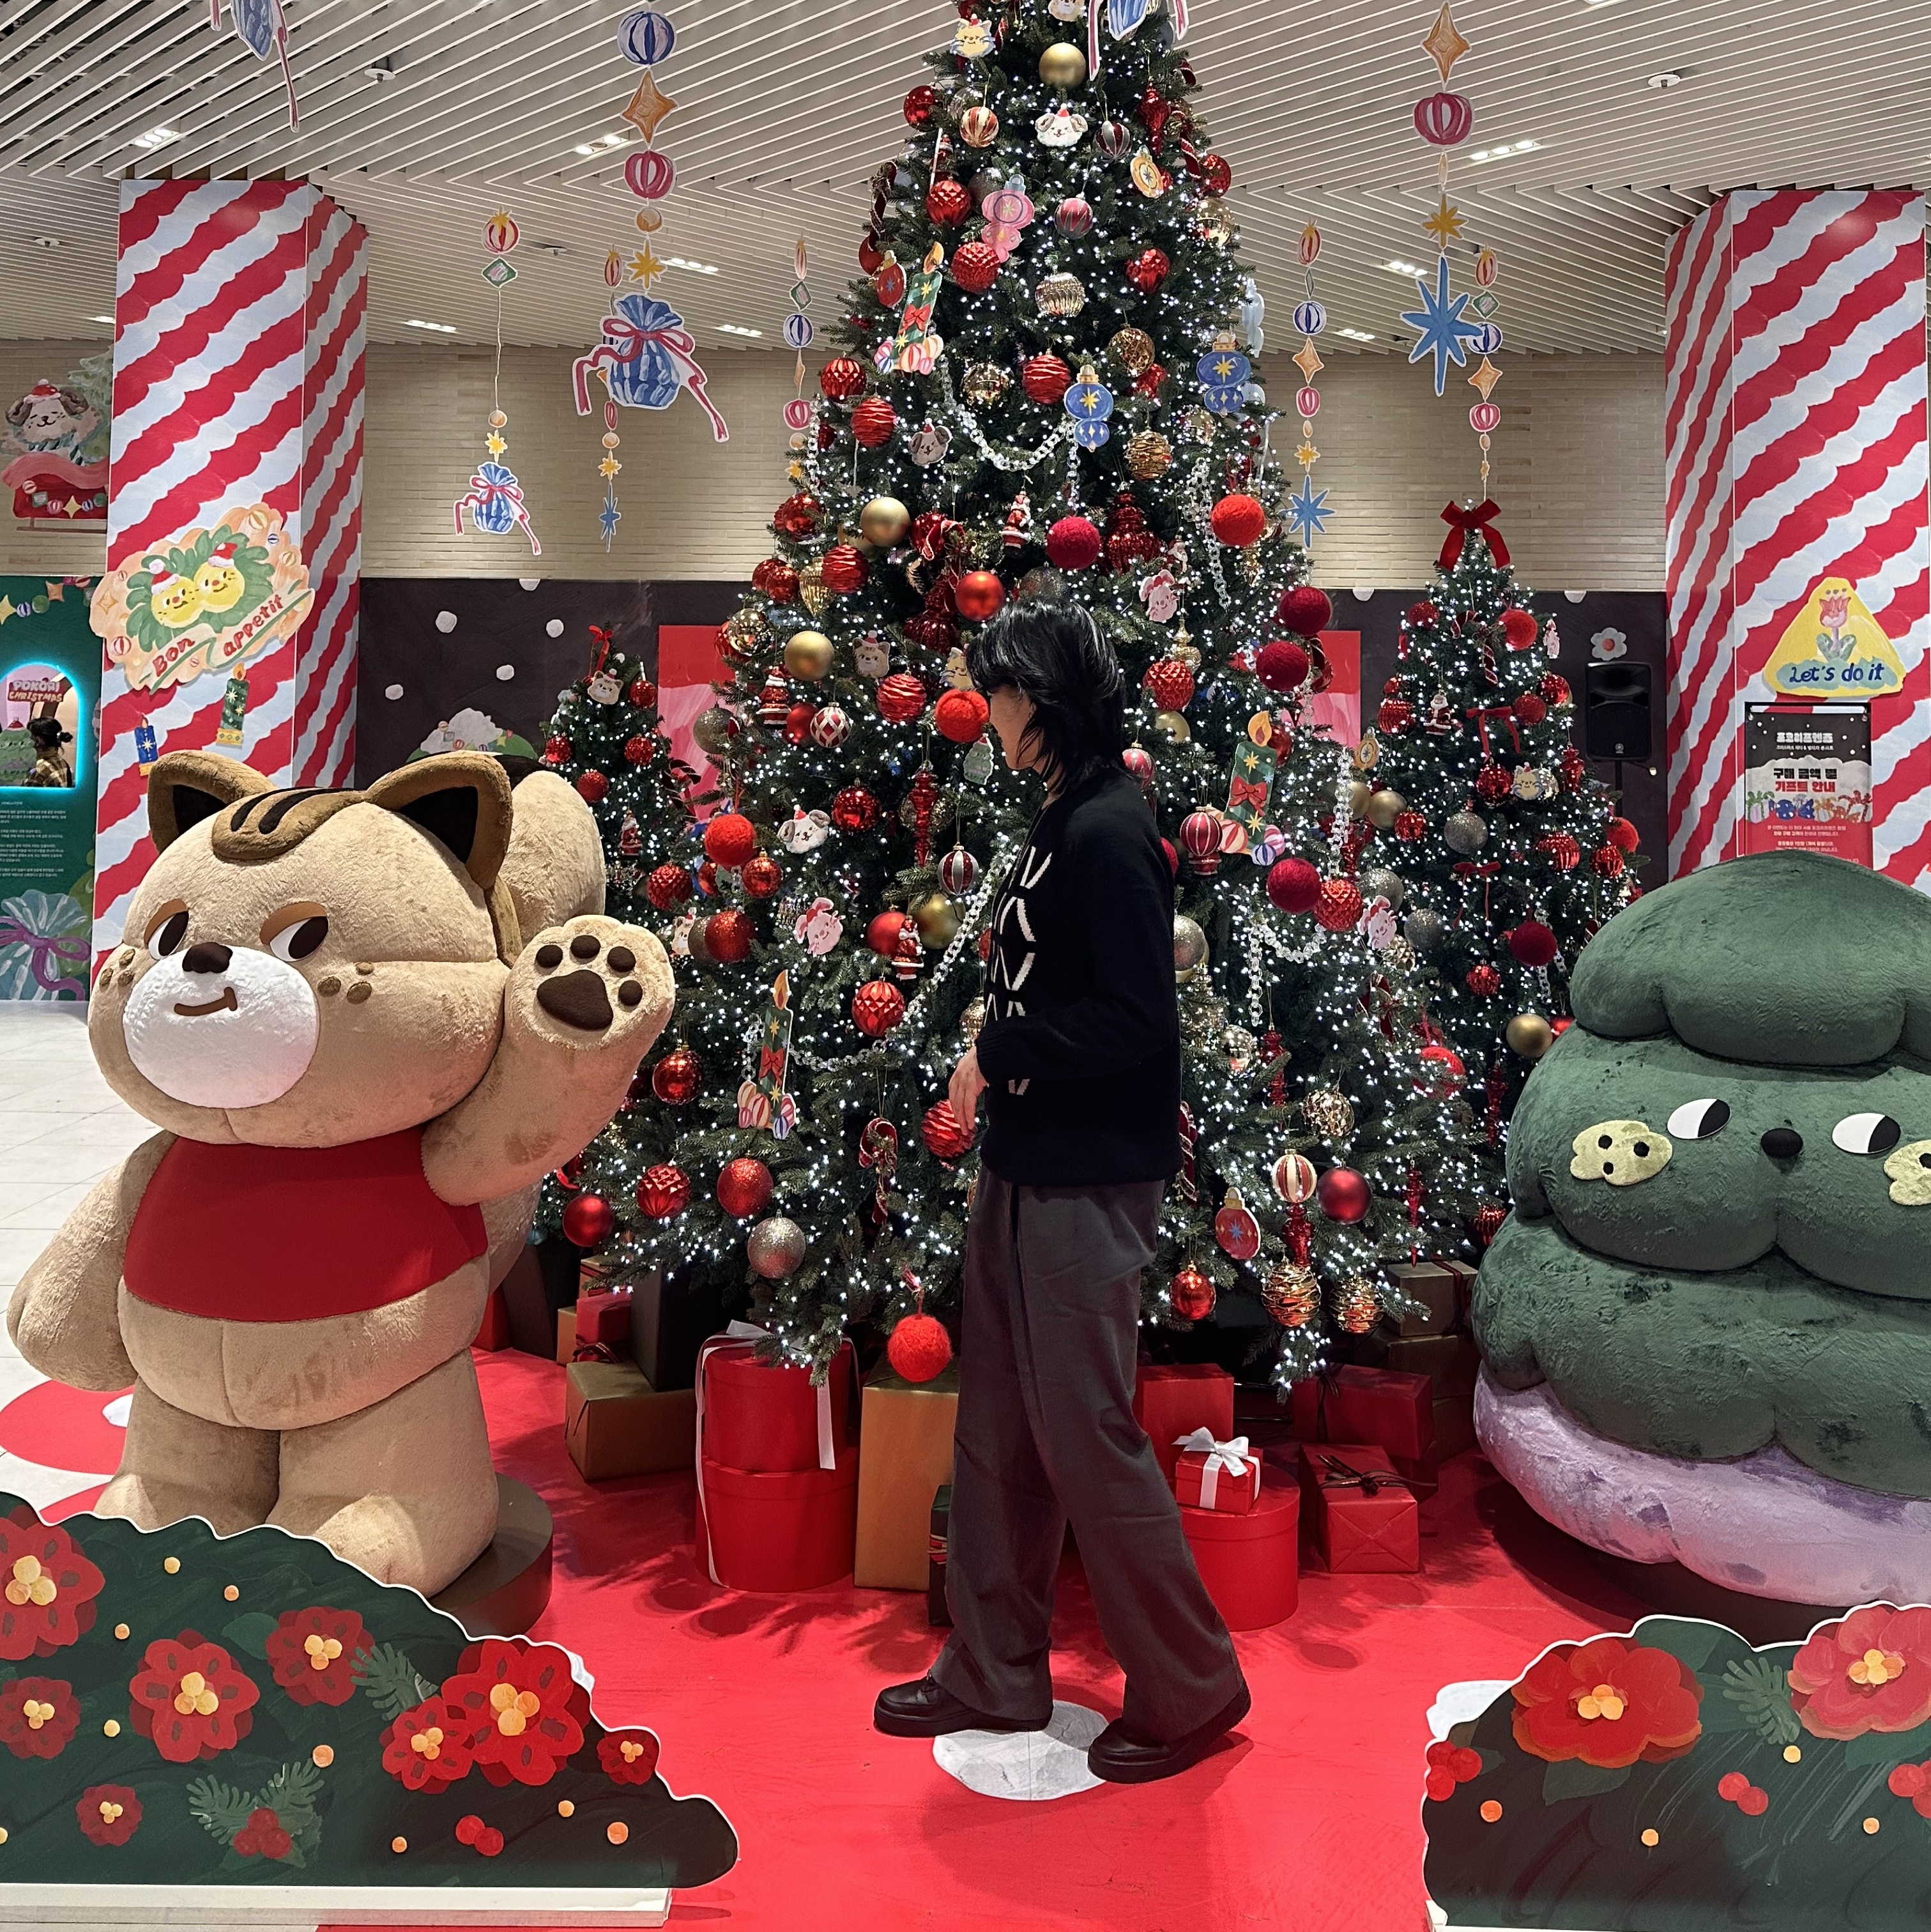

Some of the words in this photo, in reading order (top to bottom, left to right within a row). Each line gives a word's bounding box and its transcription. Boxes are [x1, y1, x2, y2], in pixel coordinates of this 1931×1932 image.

[152, 638, 195, 677] Bon
[224, 594, 284, 656] appetit
[1789, 666, 1836, 683] Let's
[1841, 663, 1864, 682] do
[1868, 663, 1885, 681] it
[8, 691, 63, 702] CHRISTMAS
[1773, 768, 1795, 779] 구매
[1775, 781, 1808, 792] 기프트
[1812, 781, 1836, 792] 안내
